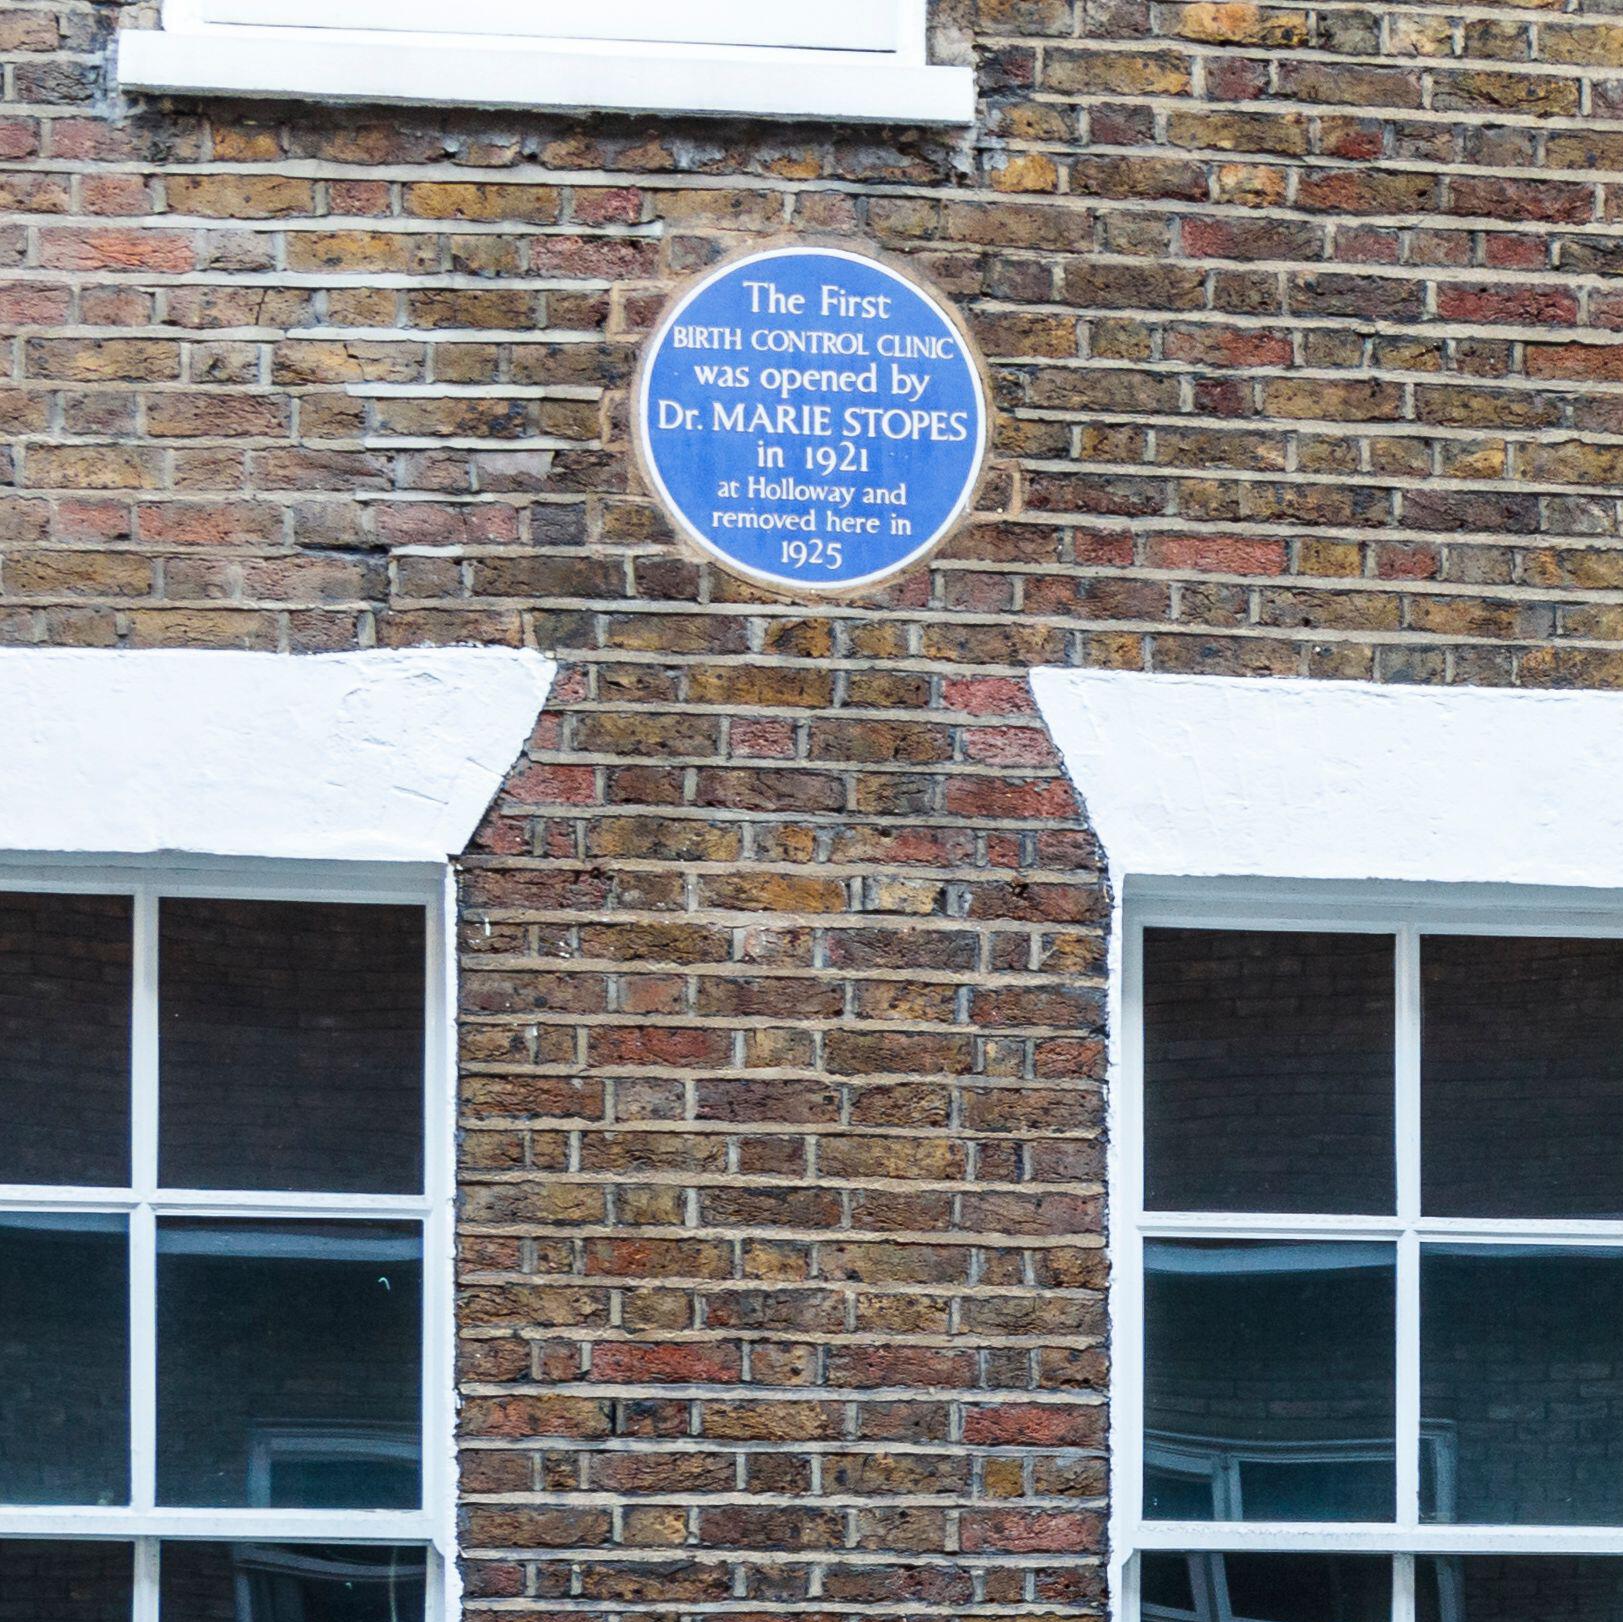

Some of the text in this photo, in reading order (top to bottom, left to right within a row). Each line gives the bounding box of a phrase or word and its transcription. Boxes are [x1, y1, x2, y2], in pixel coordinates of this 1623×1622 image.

[743, 281, 891, 318] The First
[673, 326, 954, 359] BIRTH CONTROL CLINIC
[694, 363, 930, 401] was opened by
[658, 400, 967, 441] Dr. MARIE STOPES
[757, 440, 868, 476] in 1921
[717, 477, 907, 509] at Holloway and
[712, 509, 911, 535] removed here in
[781, 540, 843, 568] 1925
